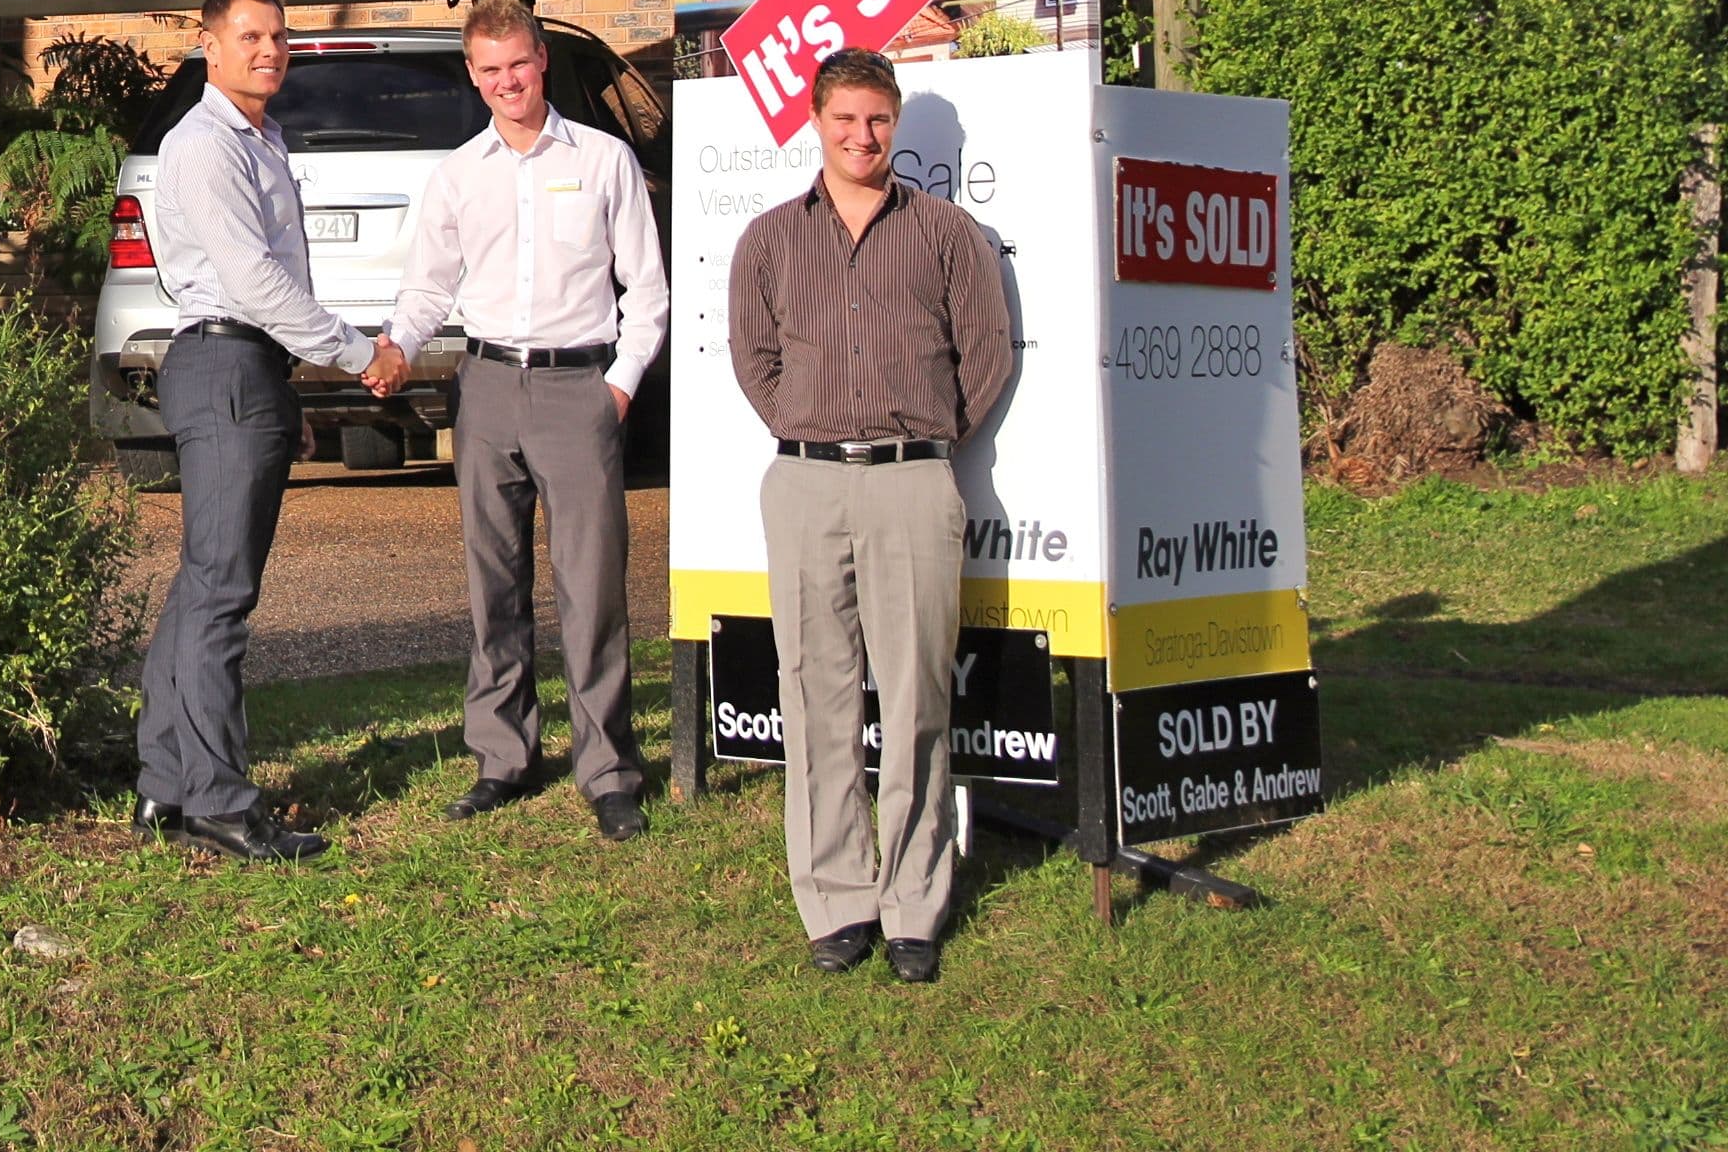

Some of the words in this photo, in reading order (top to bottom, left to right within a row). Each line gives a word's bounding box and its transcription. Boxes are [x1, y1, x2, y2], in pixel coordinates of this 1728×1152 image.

[742, 4, 844, 117] It's
[699, 141, 822, 173] Outstandin
[891, 147, 996, 203] Sale
[699, 189, 764, 216] Views
[1122, 184, 1176, 260] It's
[1185, 190, 1270, 267] SOLD
[1115, 324, 1182, 380] 4369
[1190, 324, 1262, 378] 2888
[961, 518, 1068, 562] White
[1137, 526, 1188, 586] Ray
[1193, 519, 1278, 573] White
[1144, 621, 1283, 669] Saratoga-Davistown
[717, 701, 784, 743] Scot
[949, 721, 1056, 760] ndrew
[1158, 705, 1233, 758] SOLD
[1239, 699, 1277, 746] BY
[1123, 783, 1177, 824] Scott,
[1180, 774, 1229, 813] Gabe
[1234, 769, 1248, 805] &
[1252, 763, 1321, 802] Andrew
